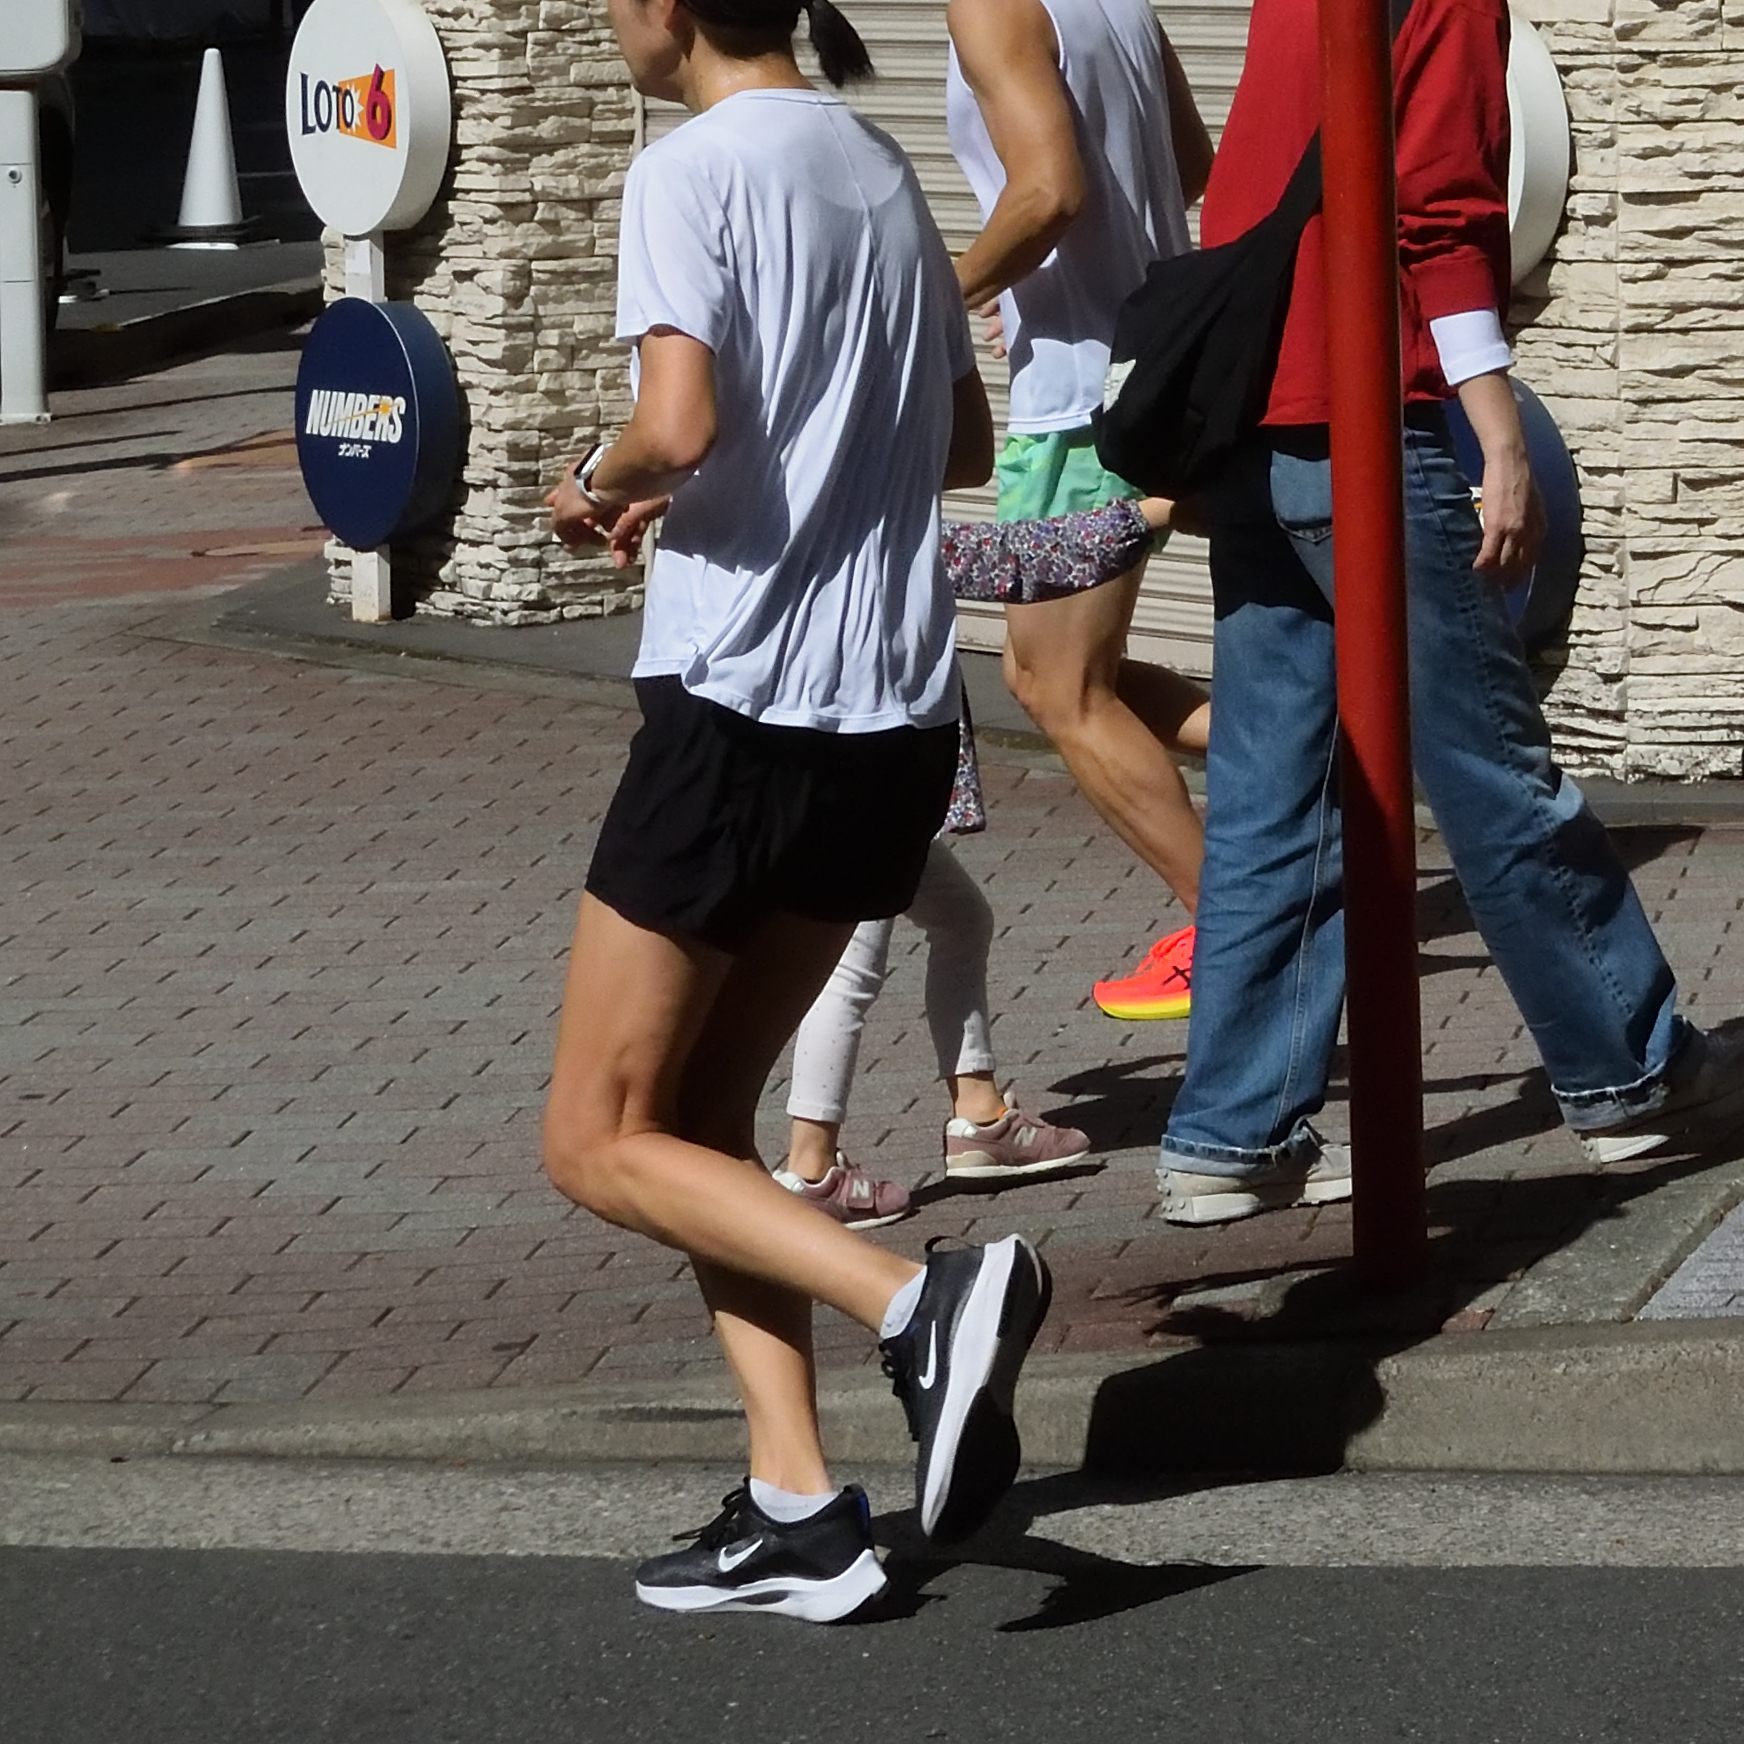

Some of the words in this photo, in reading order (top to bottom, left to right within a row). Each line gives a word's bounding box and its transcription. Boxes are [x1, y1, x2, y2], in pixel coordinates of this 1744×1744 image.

[300, 72, 354, 136] LOTO
[366, 62, 392, 140] 6
[306, 389, 406, 443] NUMBERS
[1014, 1126, 1038, 1147] N
[851, 1180, 870, 1199] N
